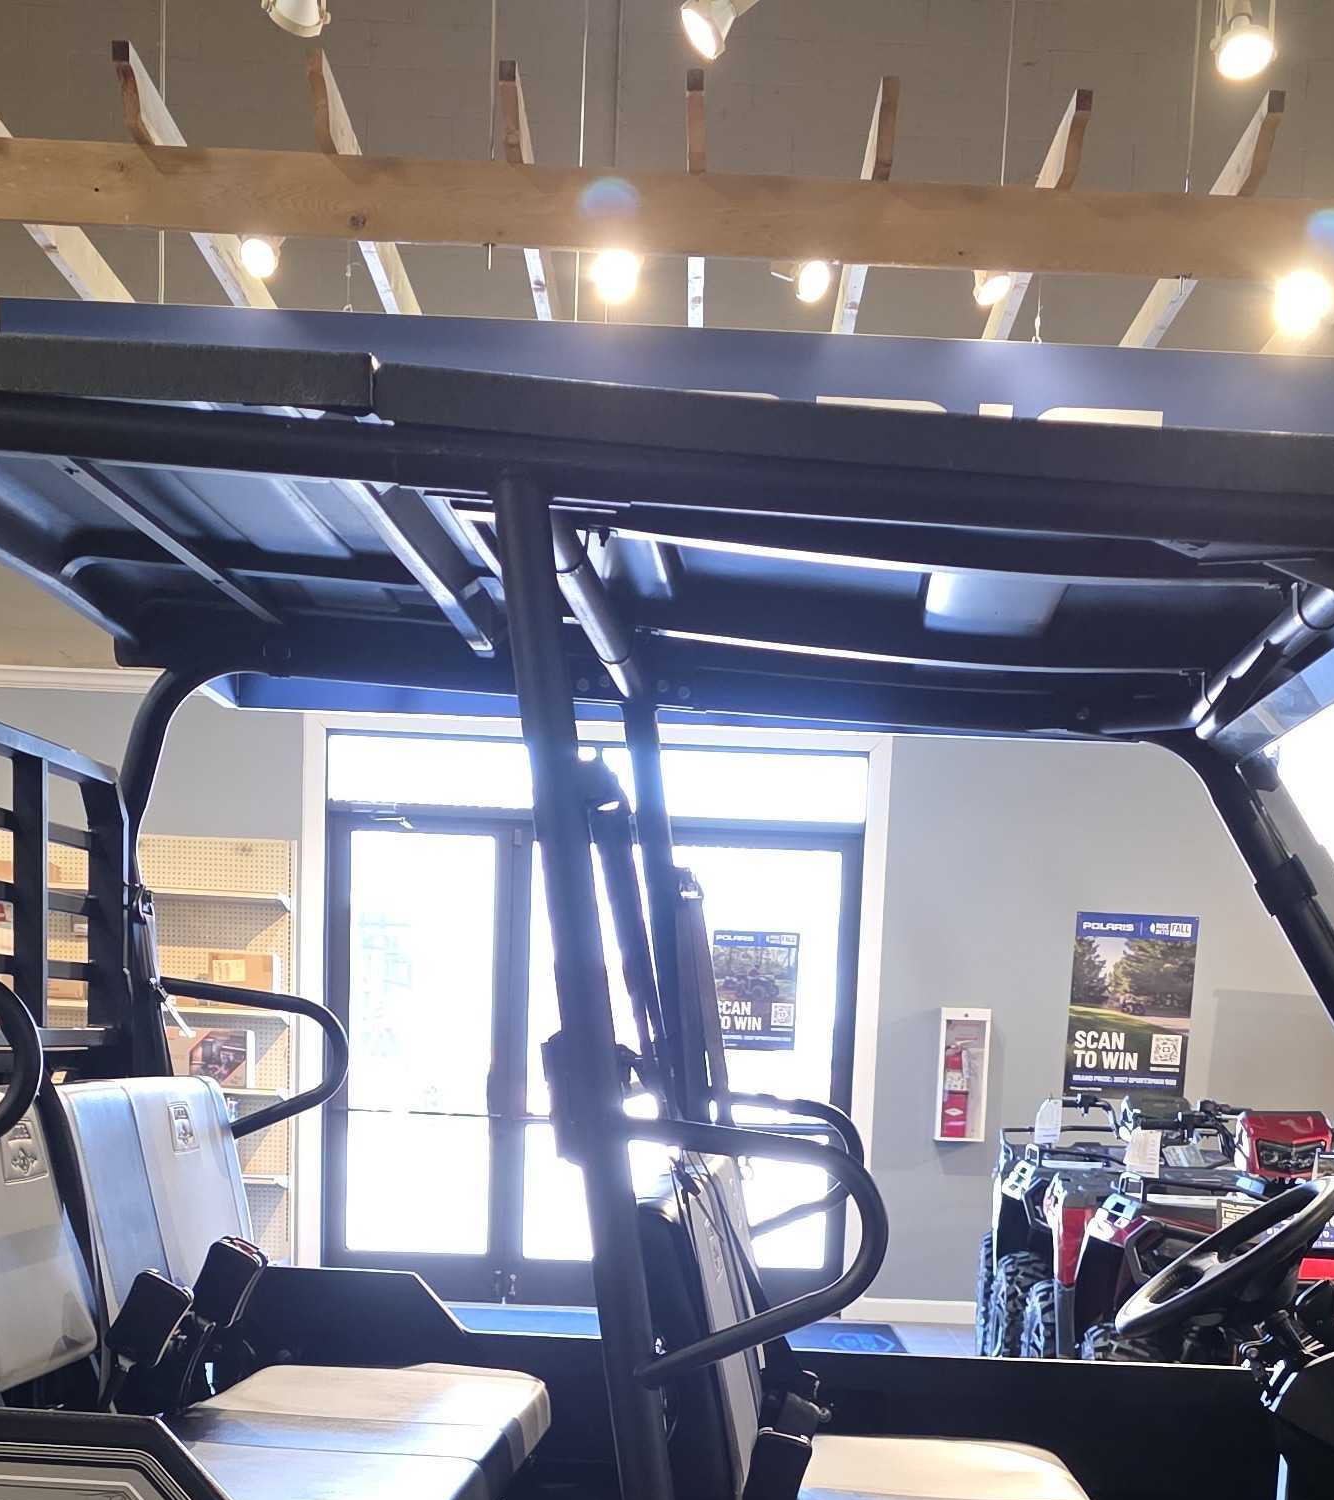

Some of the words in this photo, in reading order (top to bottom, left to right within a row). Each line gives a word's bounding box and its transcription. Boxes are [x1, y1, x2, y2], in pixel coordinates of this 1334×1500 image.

[1082, 921, 1134, 932] POLARIS
[734, 1016, 762, 1031] WIN
[1074, 1030, 1126, 1050] SCAN
[1073, 1049, 1098, 1069] TO
[1102, 1051, 1139, 1070] WIN
